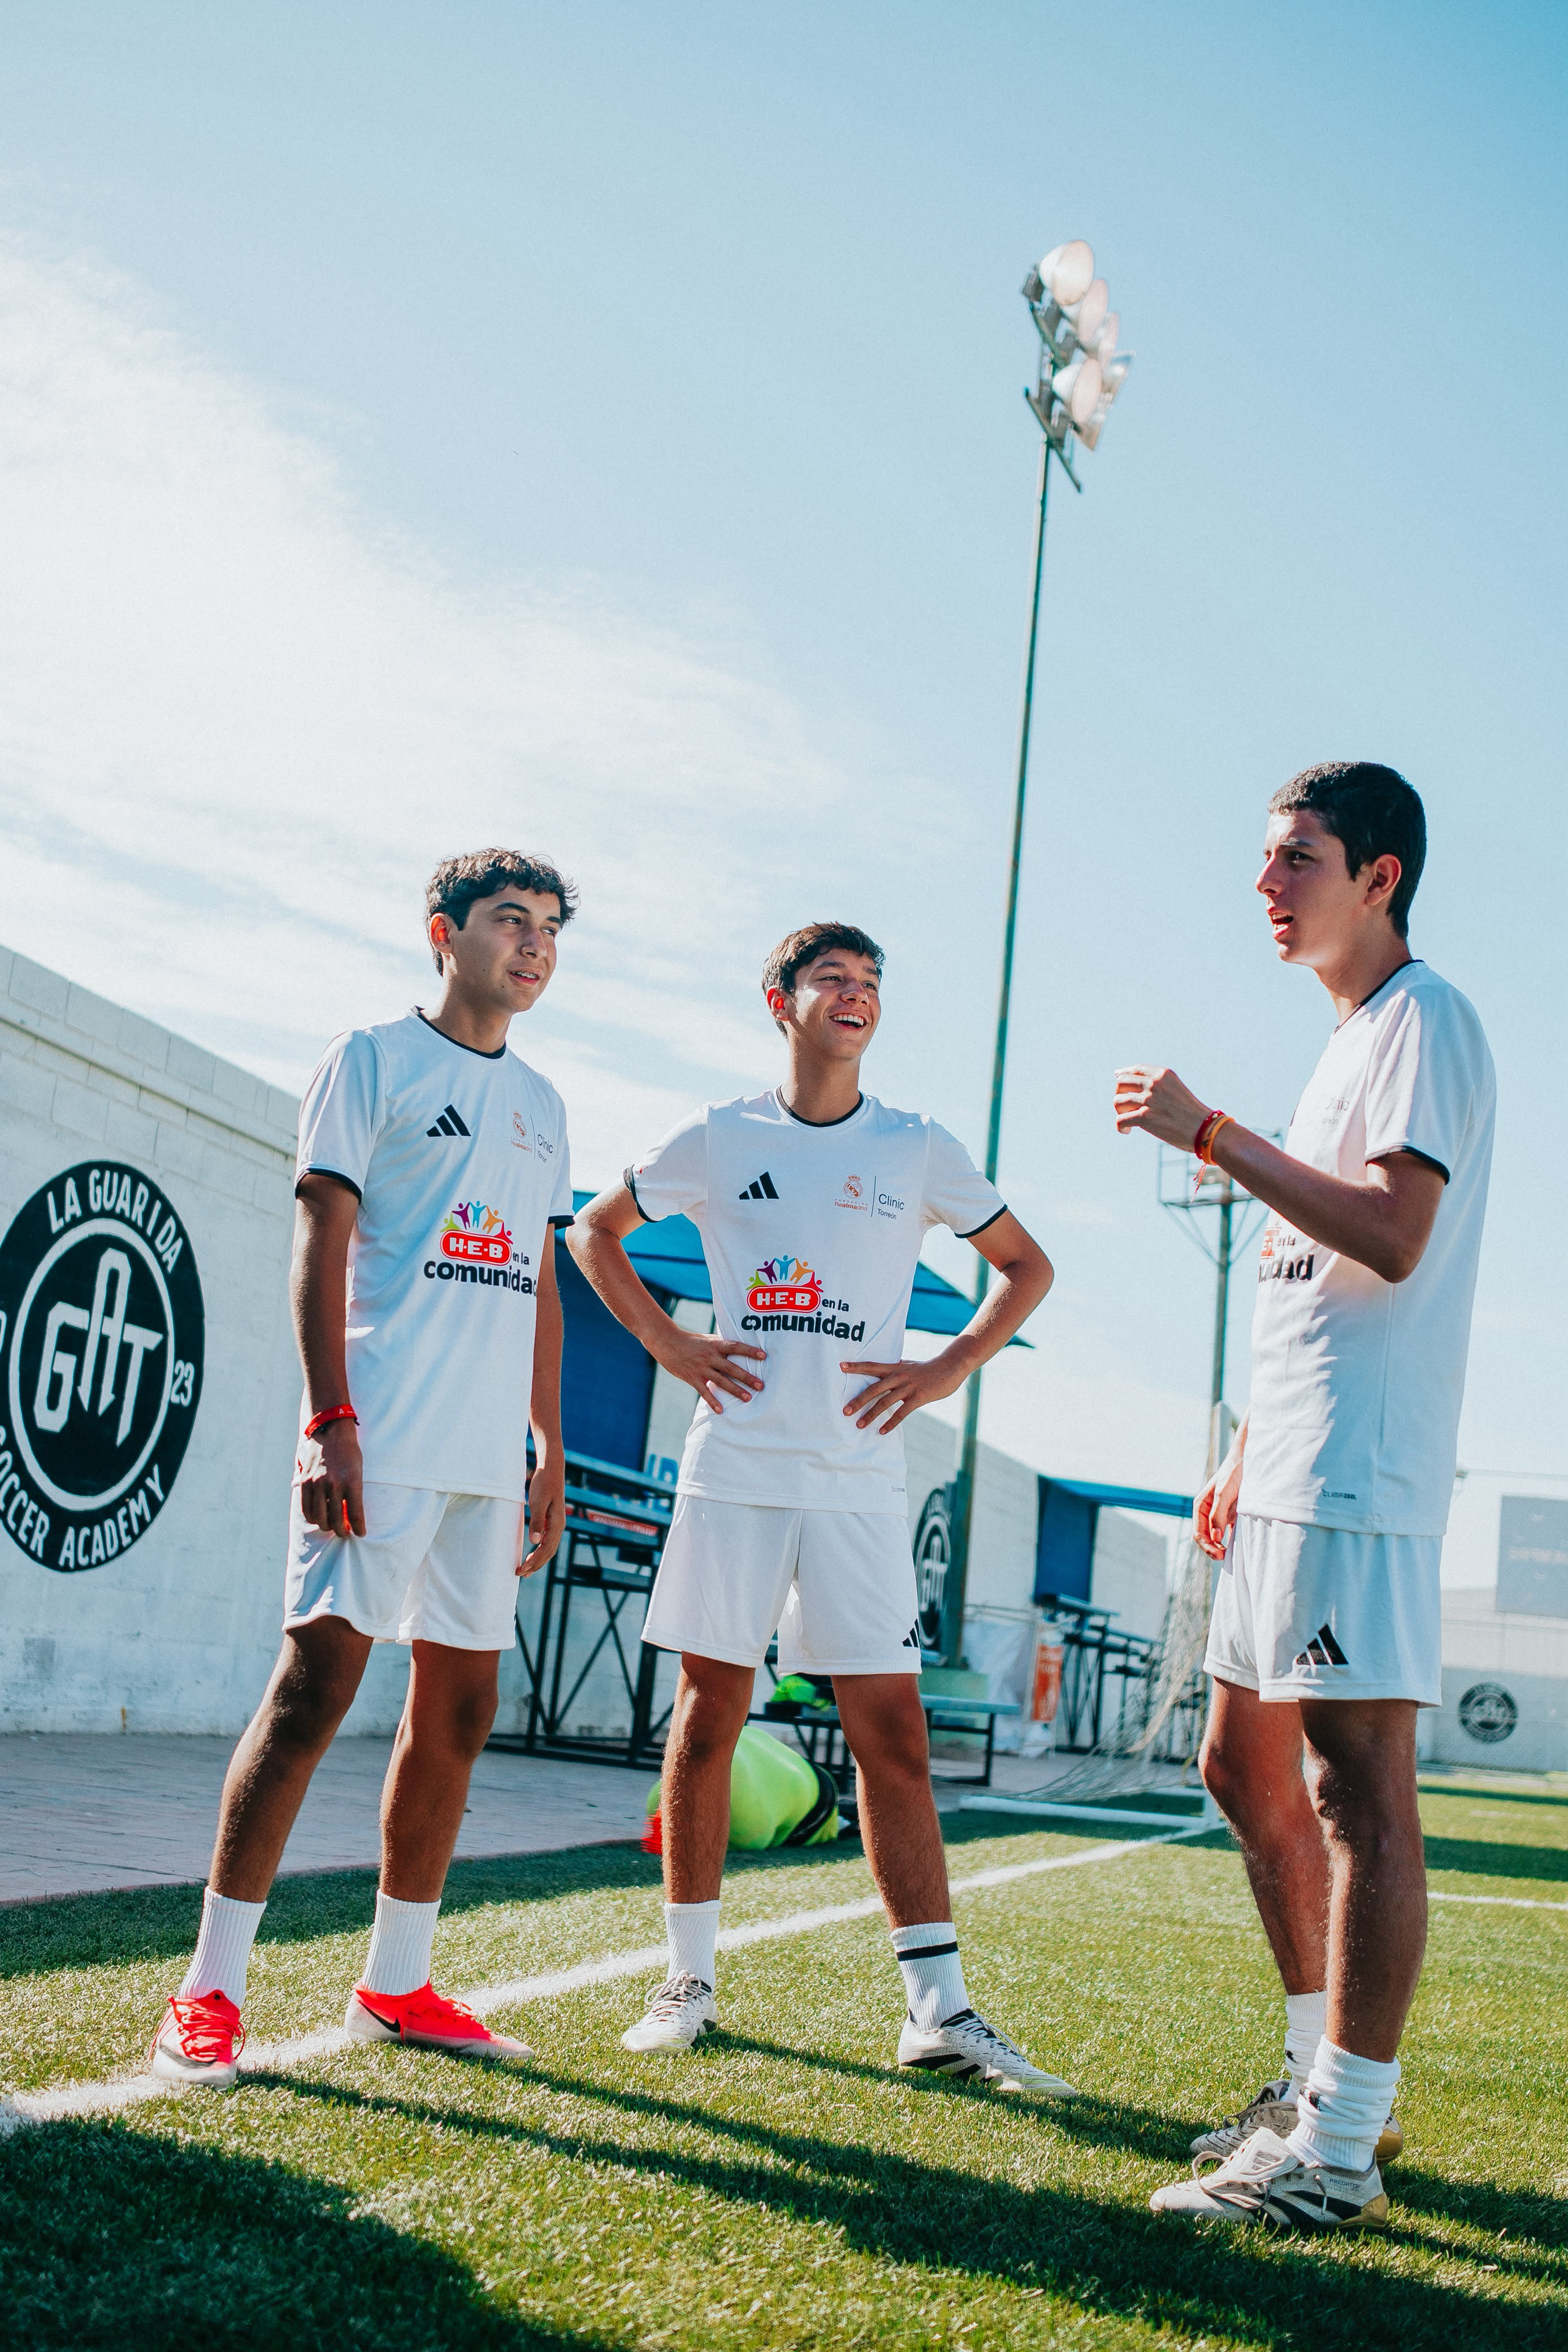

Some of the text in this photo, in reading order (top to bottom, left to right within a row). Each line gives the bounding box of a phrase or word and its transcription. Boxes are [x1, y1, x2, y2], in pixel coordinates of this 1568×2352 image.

[538, 1134, 553, 1154] Clinic
[878, 1194, 905, 1210] Clinic
[47, 1168, 184, 1274] LA GUARIDA
[877, 1208, 897, 1220] Torreón
[521, 1252, 530, 1265] la
[822, 1298, 835, 1309] en
[837, 1299, 850, 1312] la
[740, 1311, 866, 1343] comunidad
[170, 1359, 195, 1407] 23
[59, 1464, 165, 1570] ACADEMY
